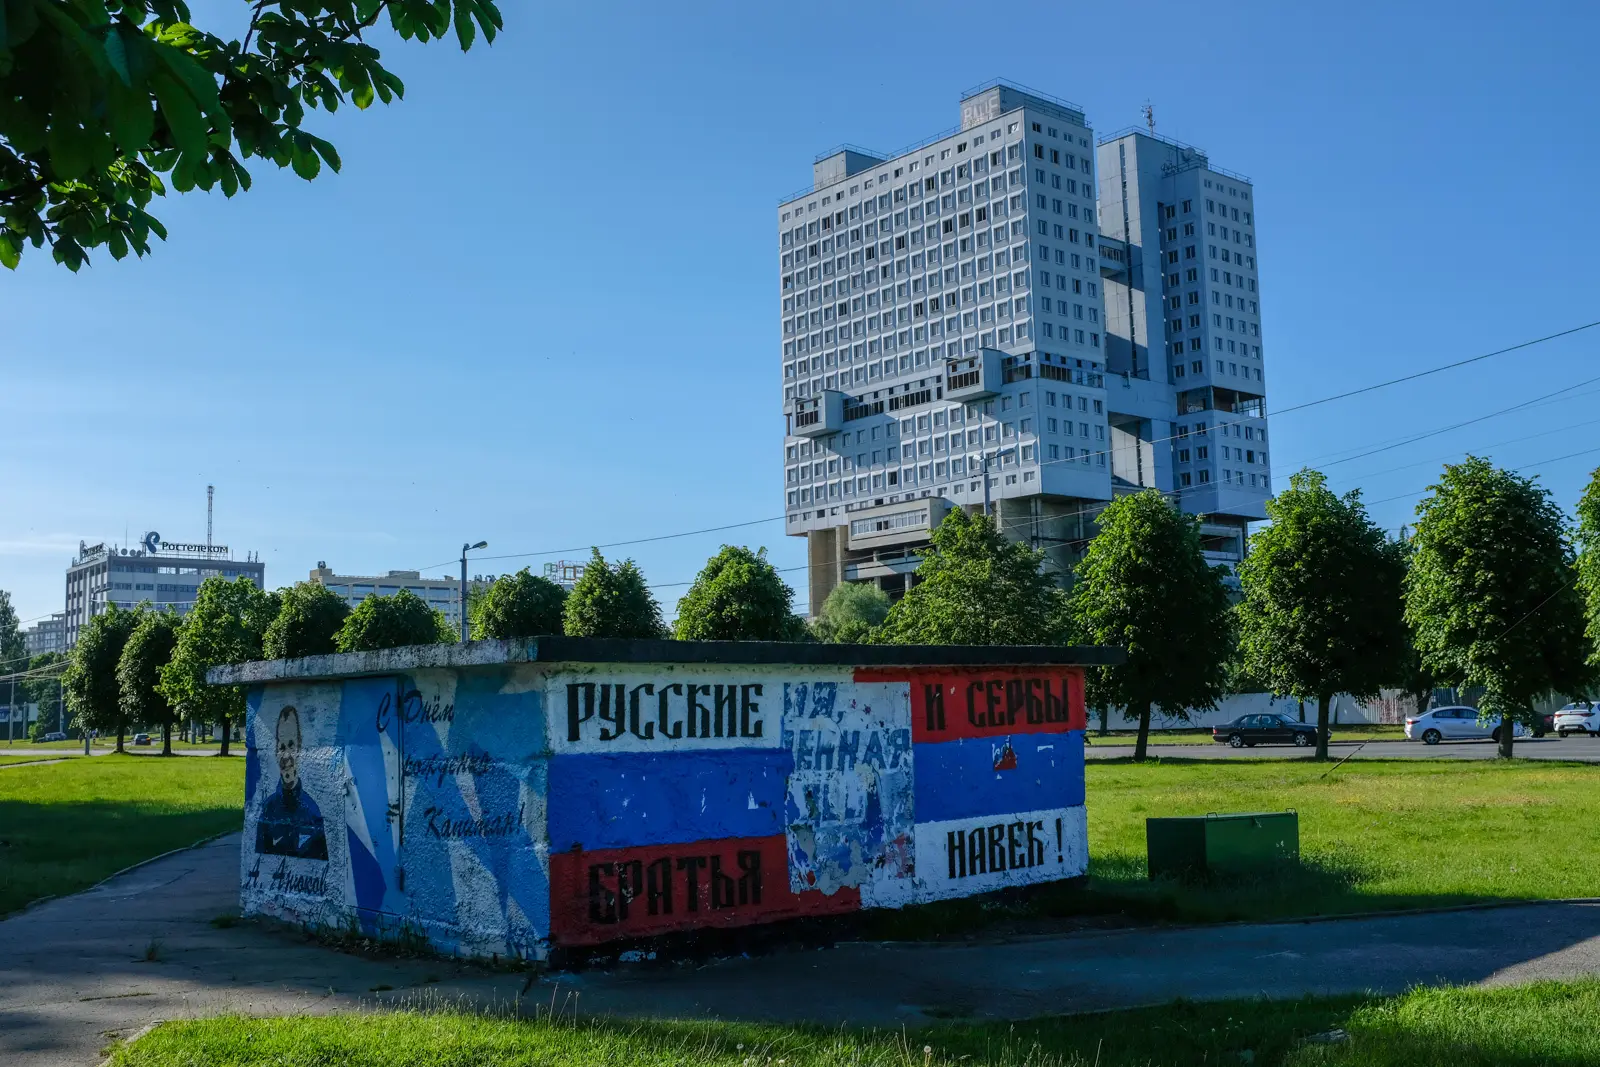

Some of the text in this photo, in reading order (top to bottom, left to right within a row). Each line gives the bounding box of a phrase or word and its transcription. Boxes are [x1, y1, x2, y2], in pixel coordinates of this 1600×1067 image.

[162, 541, 229, 554] Ростелеком
[376, 689, 455, 734] С Днём
[566, 682, 764, 741] РУССКИЕ
[924, 678, 1070, 731] И СЕРБЫ
[589, 849, 763, 924] БРАТЬЯ
